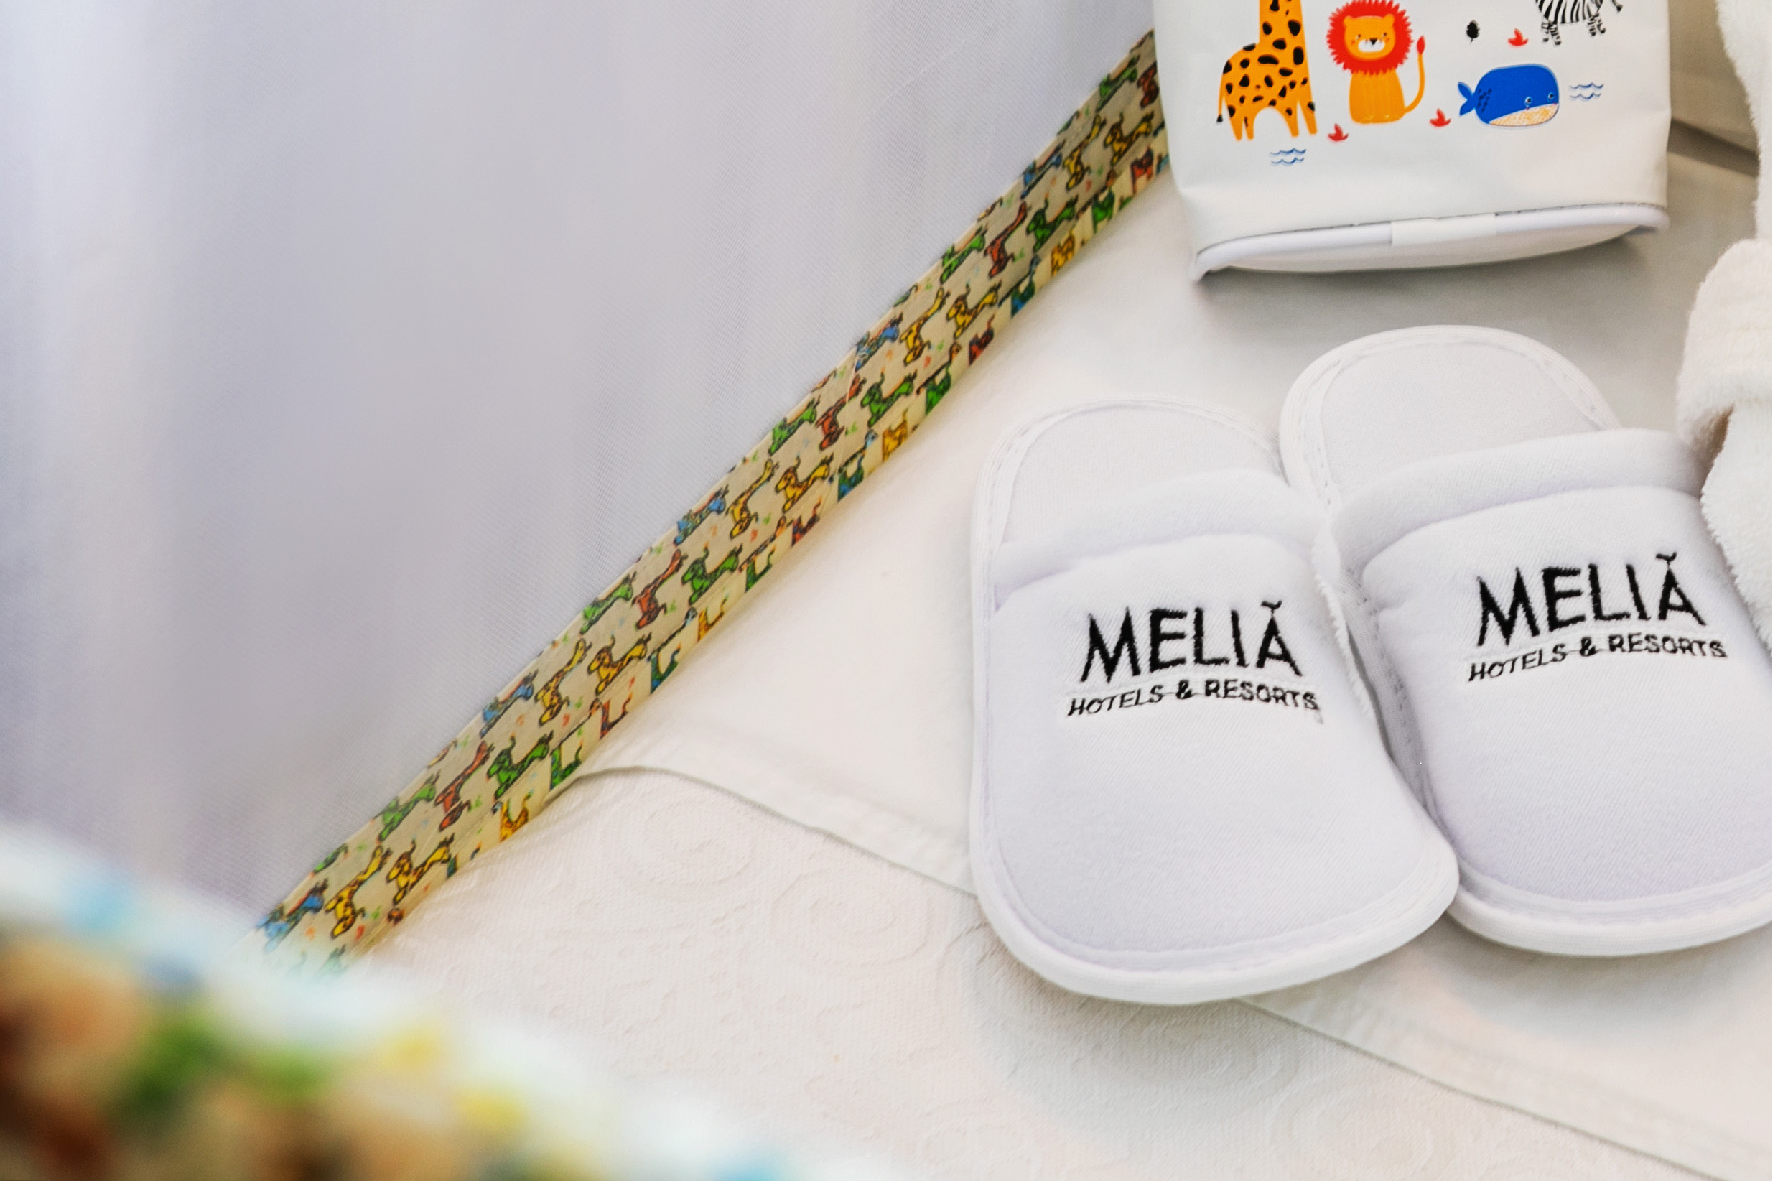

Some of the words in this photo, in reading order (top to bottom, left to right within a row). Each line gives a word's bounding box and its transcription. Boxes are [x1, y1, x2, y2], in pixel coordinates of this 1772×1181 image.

[1467, 642, 1567, 682] HOTELS
[1578, 636, 1599, 658] &
[1608, 632, 1728, 658] RESORTS
[1067, 684, 1164, 717] HOTELS
[1174, 679, 1193, 700] &
[1204, 679, 1320, 712] RESORTS
